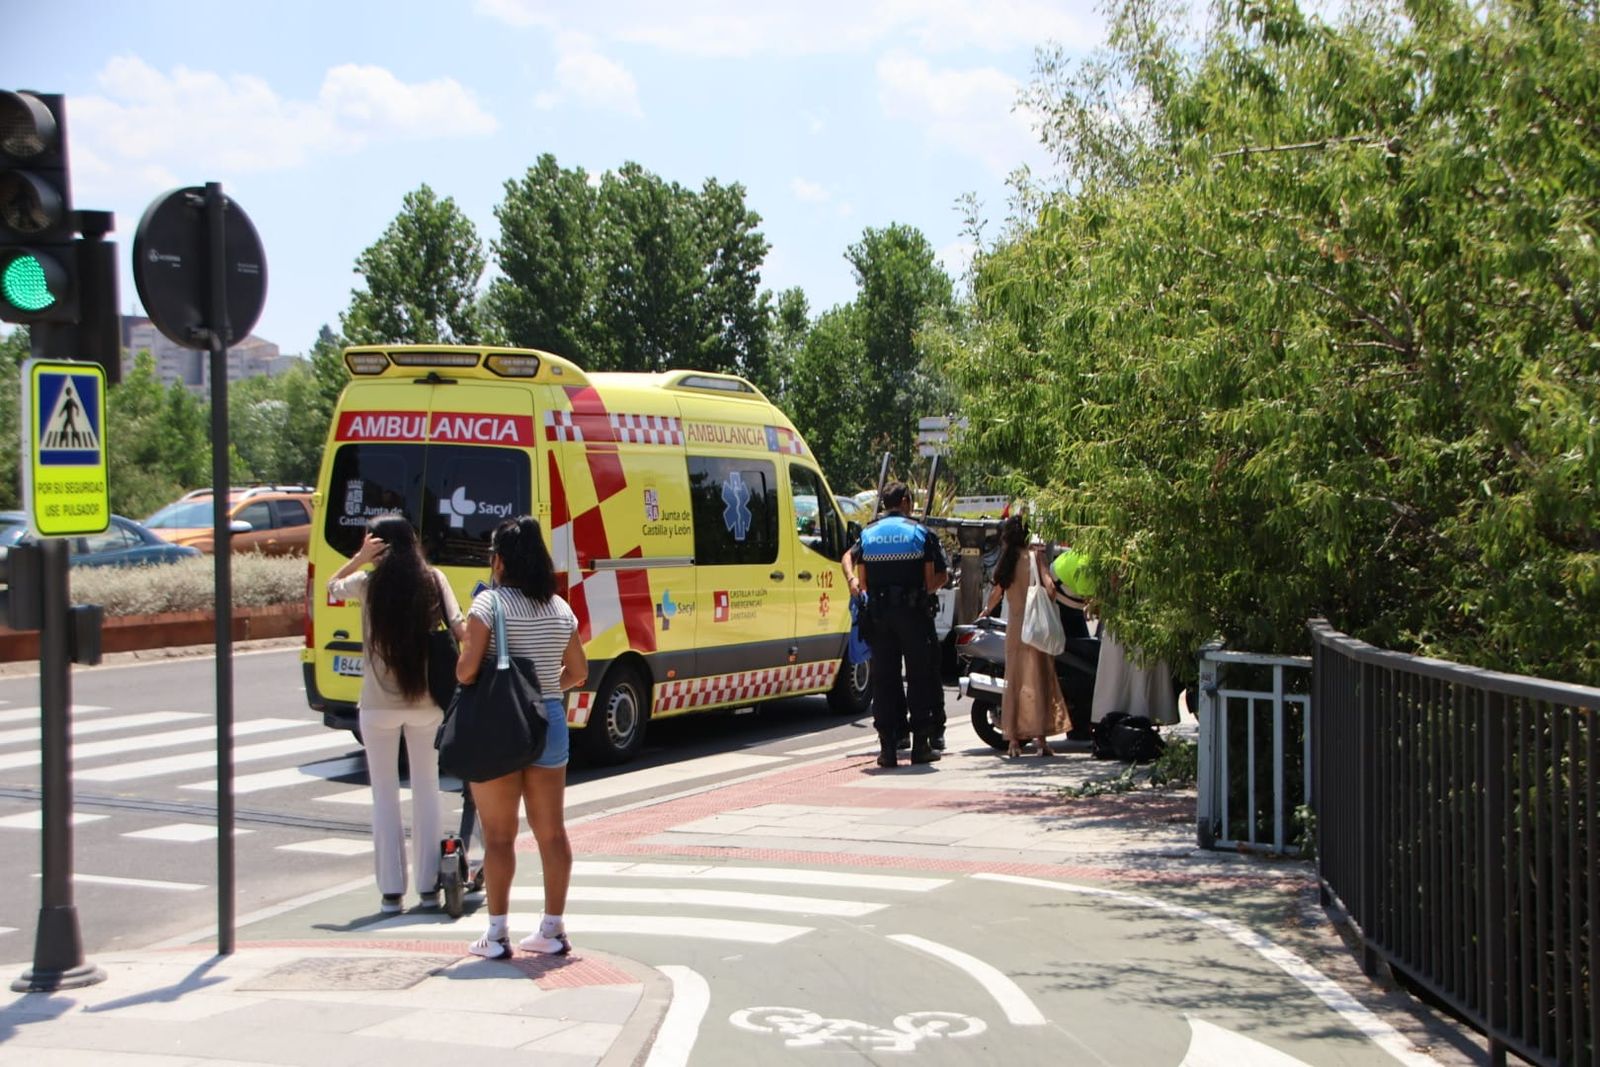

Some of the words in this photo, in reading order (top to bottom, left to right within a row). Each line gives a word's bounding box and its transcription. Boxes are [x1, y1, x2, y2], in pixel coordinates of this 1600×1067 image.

[347, 415, 519, 441] AMBULANCIA
[688, 424, 765, 446] AMBULANCIA
[478, 502, 512, 518] Sacyl
[661, 510, 680, 521] Junta
[682, 510, 690, 521] de
[642, 524, 667, 536] Castilla
[669, 527, 673, 539] y
[677, 601, 695, 616] Sacyl
[341, 658, 363, 671] 844
